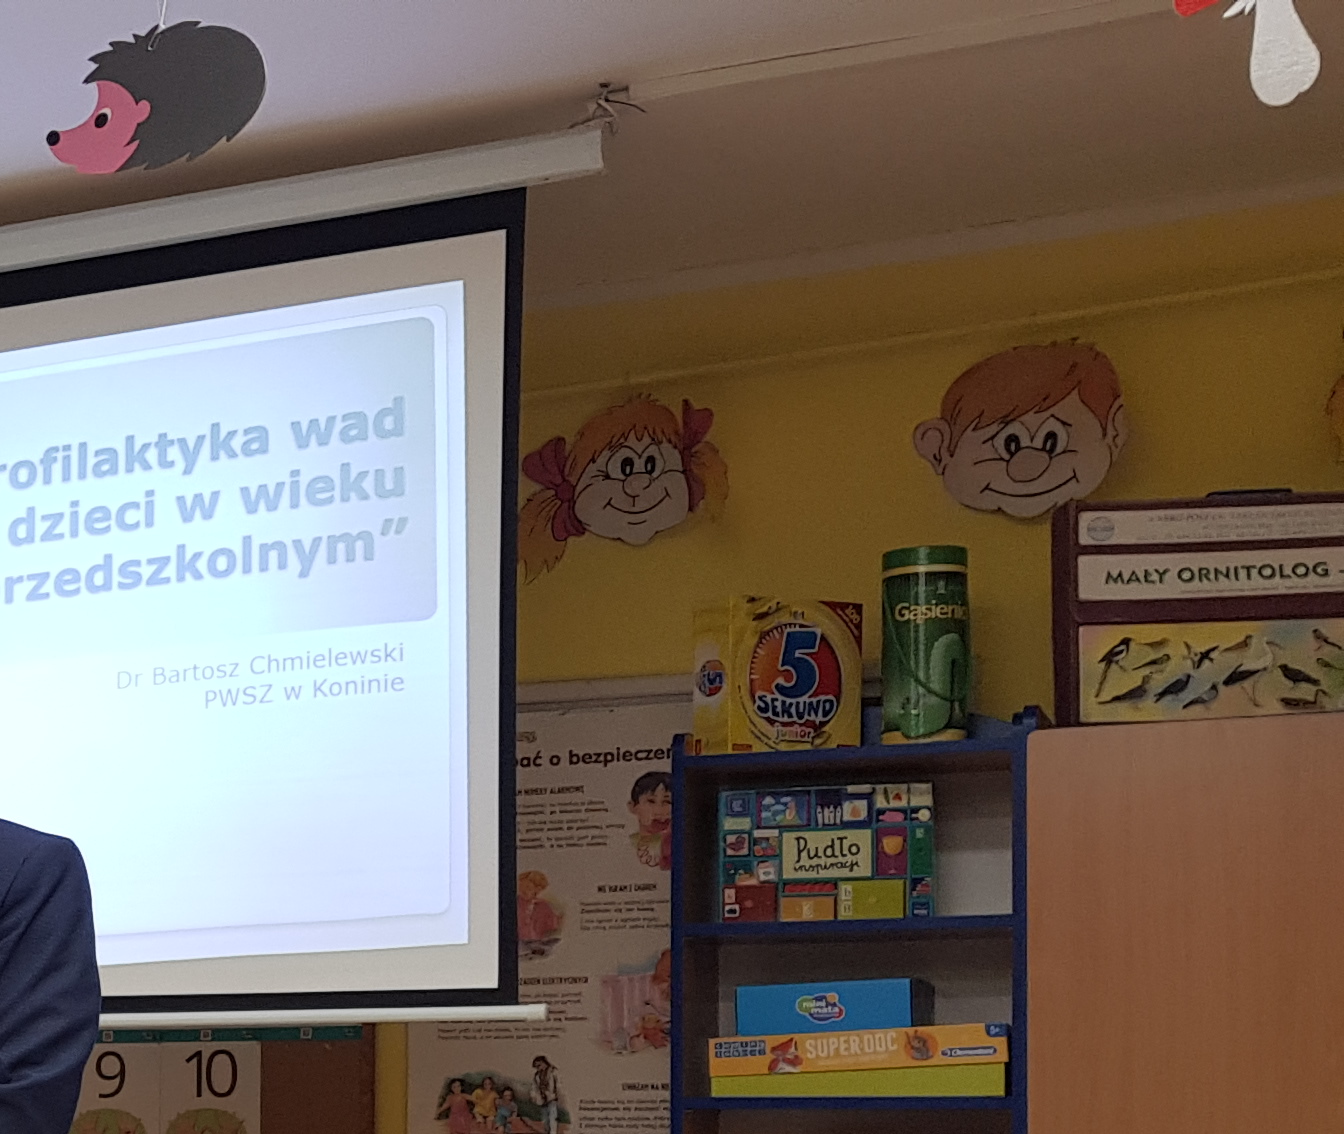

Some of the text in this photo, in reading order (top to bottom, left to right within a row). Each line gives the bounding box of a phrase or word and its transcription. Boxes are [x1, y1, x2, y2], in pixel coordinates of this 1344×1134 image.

[290, 395, 406, 451] wad
[8, 489, 155, 548] dzieci
[175, 491, 221, 521] w
[240, 462, 406, 516] wieku
[1104, 561, 1330, 585] MAŁY ORNITOLOG
[116, 642, 406, 690] Dr Bartosz Chmielewski
[774, 630, 819, 699] 5
[204, 673, 406, 709] PWSZ w Koninie
[756, 694, 836, 720] SEKUND
[516, 750, 543, 768] ać
[549, 754, 561, 766] o
[95, 1049, 238, 1098] 9 10
